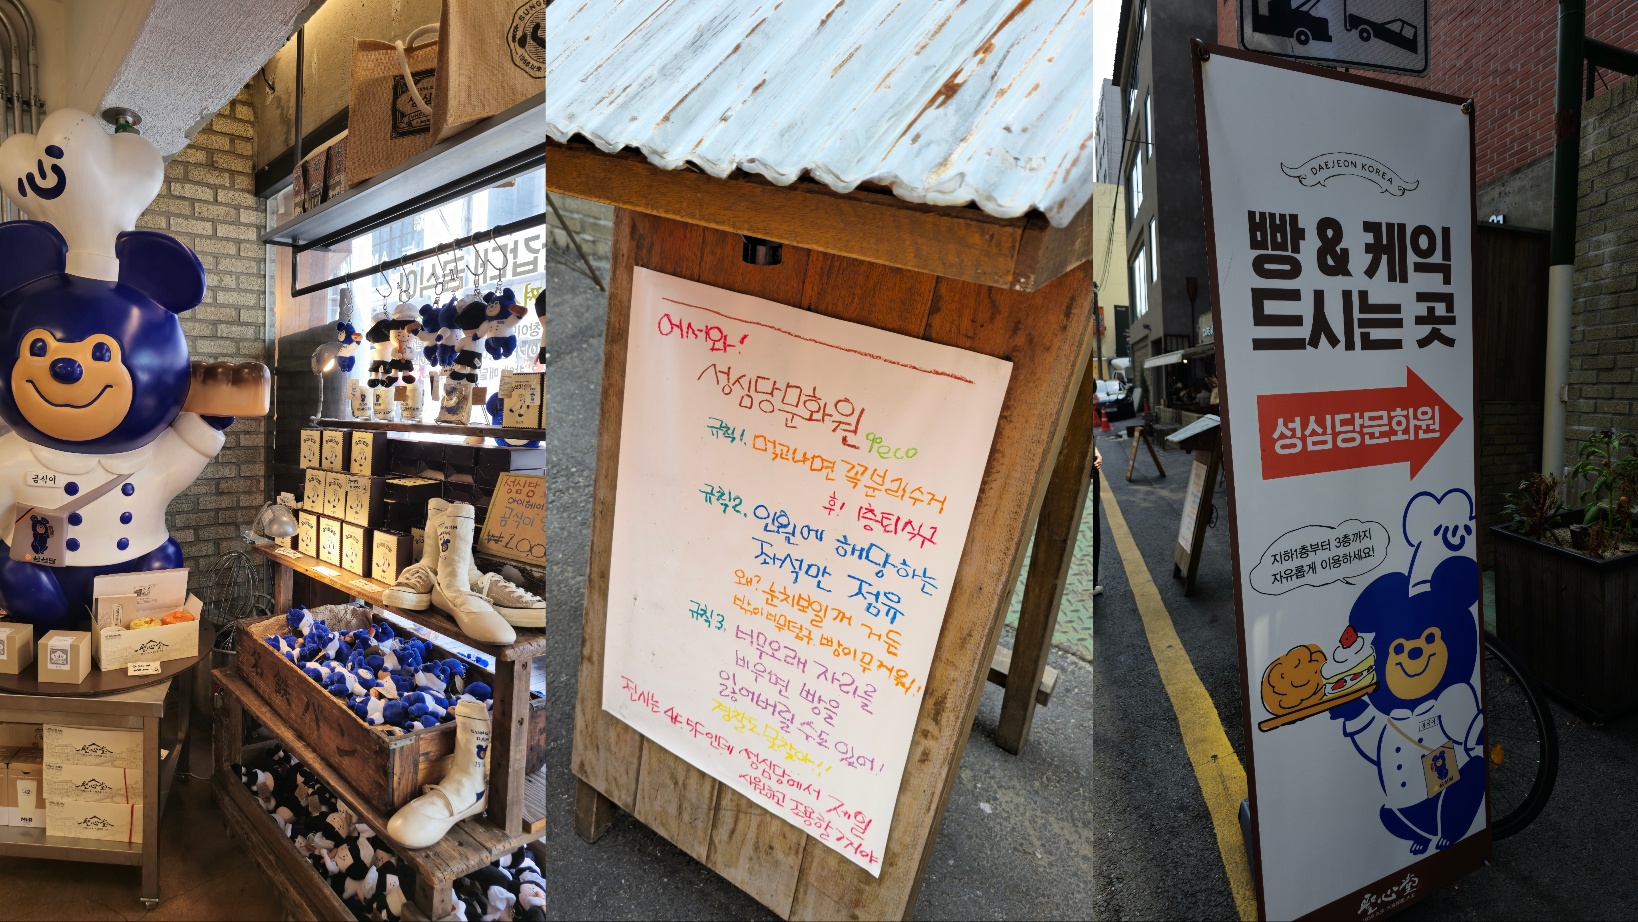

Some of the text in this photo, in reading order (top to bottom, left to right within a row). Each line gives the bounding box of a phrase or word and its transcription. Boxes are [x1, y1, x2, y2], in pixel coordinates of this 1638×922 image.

[1310, 159, 1394, 185] DAEJEON KOREA
[1248, 210, 1452, 285] 빵 & 케익
[658, 313, 749, 354] 어서와!
[1251, 287, 1456, 351] 드시는 곳
[697, 364, 865, 449] 성심당문화원
[1272, 406, 1441, 455] 성심당문화원
[32, 474, 56, 485] 곰식이
[503, 476, 540, 498] 성심당
[500, 506, 535, 529] 곰식이
[754, 504, 825, 545] 인원에
[834, 535, 938, 596] 해당하는
[1271, 528, 1372, 566] 지하1층부터 3층까지
[1271, 545, 1375, 585] 자유롭게 이용하세요!
[734, 569, 761, 591] 왜?
[752, 537, 906, 625] 좌석만 점유
[735, 650, 841, 728] 비우면 빵을
[813, 660, 877, 715] 자리를
[621, 675, 661, 714] 전시는
[738, 747, 821, 801] 성심당에서
[826, 793, 873, 841] 제일
